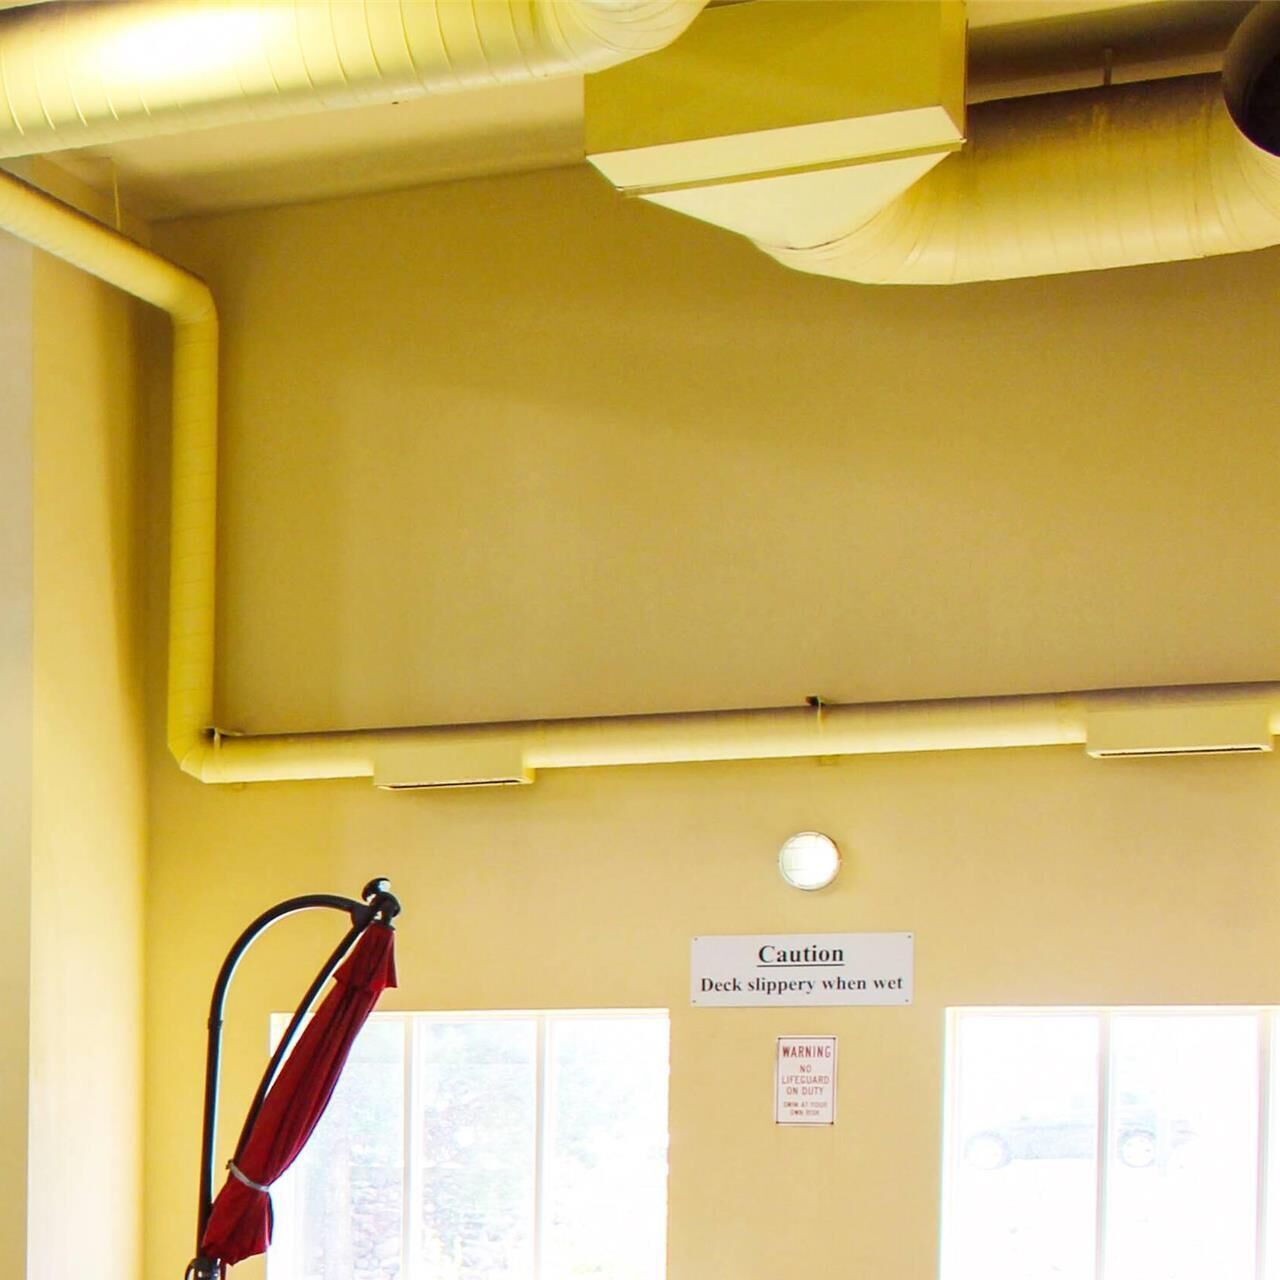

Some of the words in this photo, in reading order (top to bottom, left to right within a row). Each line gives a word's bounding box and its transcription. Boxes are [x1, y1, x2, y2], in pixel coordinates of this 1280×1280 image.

[758, 944, 845, 963] Caution
[701, 977, 742, 992] Deck
[748, 976, 816, 995] slippery
[822, 976, 867, 990] when
[873, 976, 904, 990] wet
[782, 1045, 831, 1058] WARNING
[799, 1065, 812, 1073] NO
[781, 1075, 830, 1085] LIFEGUARD
[786, 1086, 798, 1095] ON
[802, 1086, 824, 1095] DUTY
